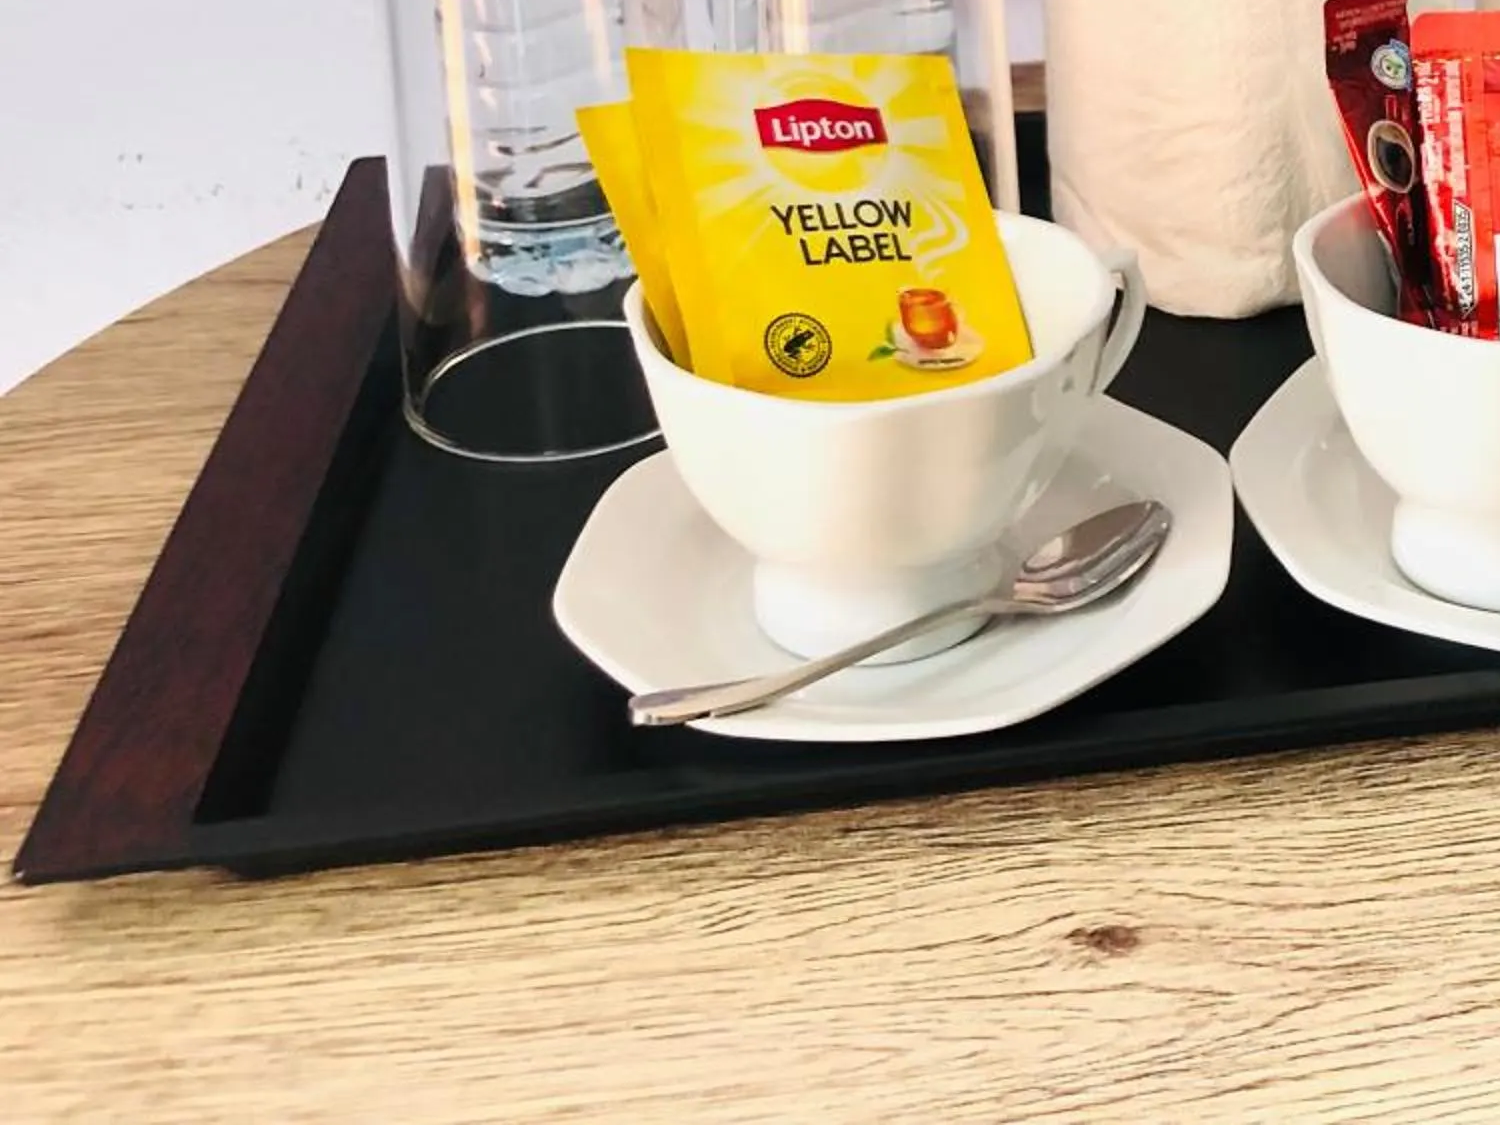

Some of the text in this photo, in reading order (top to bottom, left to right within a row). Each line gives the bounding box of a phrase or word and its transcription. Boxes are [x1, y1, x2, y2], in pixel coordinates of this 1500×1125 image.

[771, 115, 875, 148] Lipton
[770, 199, 912, 235] YELLOW
[800, 233, 912, 266] LABEL
